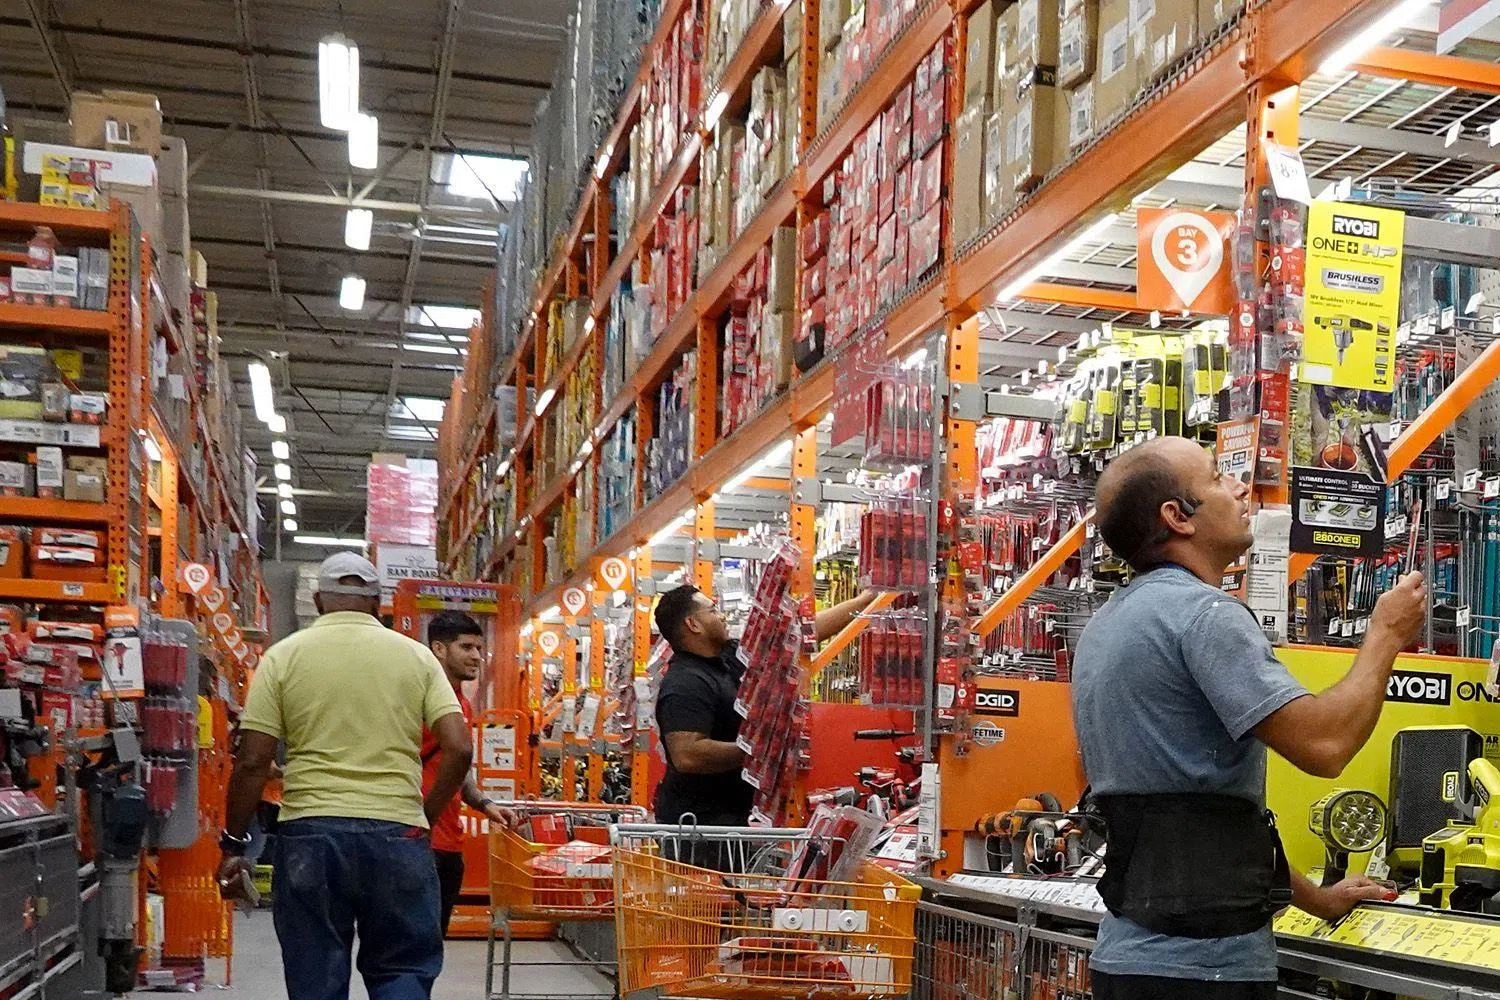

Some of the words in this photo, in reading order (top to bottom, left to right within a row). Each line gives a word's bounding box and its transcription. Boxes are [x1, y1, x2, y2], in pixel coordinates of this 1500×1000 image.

[1177, 228, 1198, 238] BAY
[1335, 216, 1378, 238] RYOBI
[1176, 240, 1198, 265] 3
[1362, 243, 1398, 259] HP
[1327, 271, 1380, 286] BRUSHLESS
[1221, 423, 1256, 438] POWERFUL
[1223, 436, 1252, 450] SAVINGS
[411, 569, 438, 578] BOAR
[1222, 576, 1235, 586] FREE
[1386, 675, 1447, 701] RYOBI
[975, 693, 1015, 707] DGID
[974, 728, 1004, 738] FETIME
[1448, 776, 1456, 800] RYOBI
